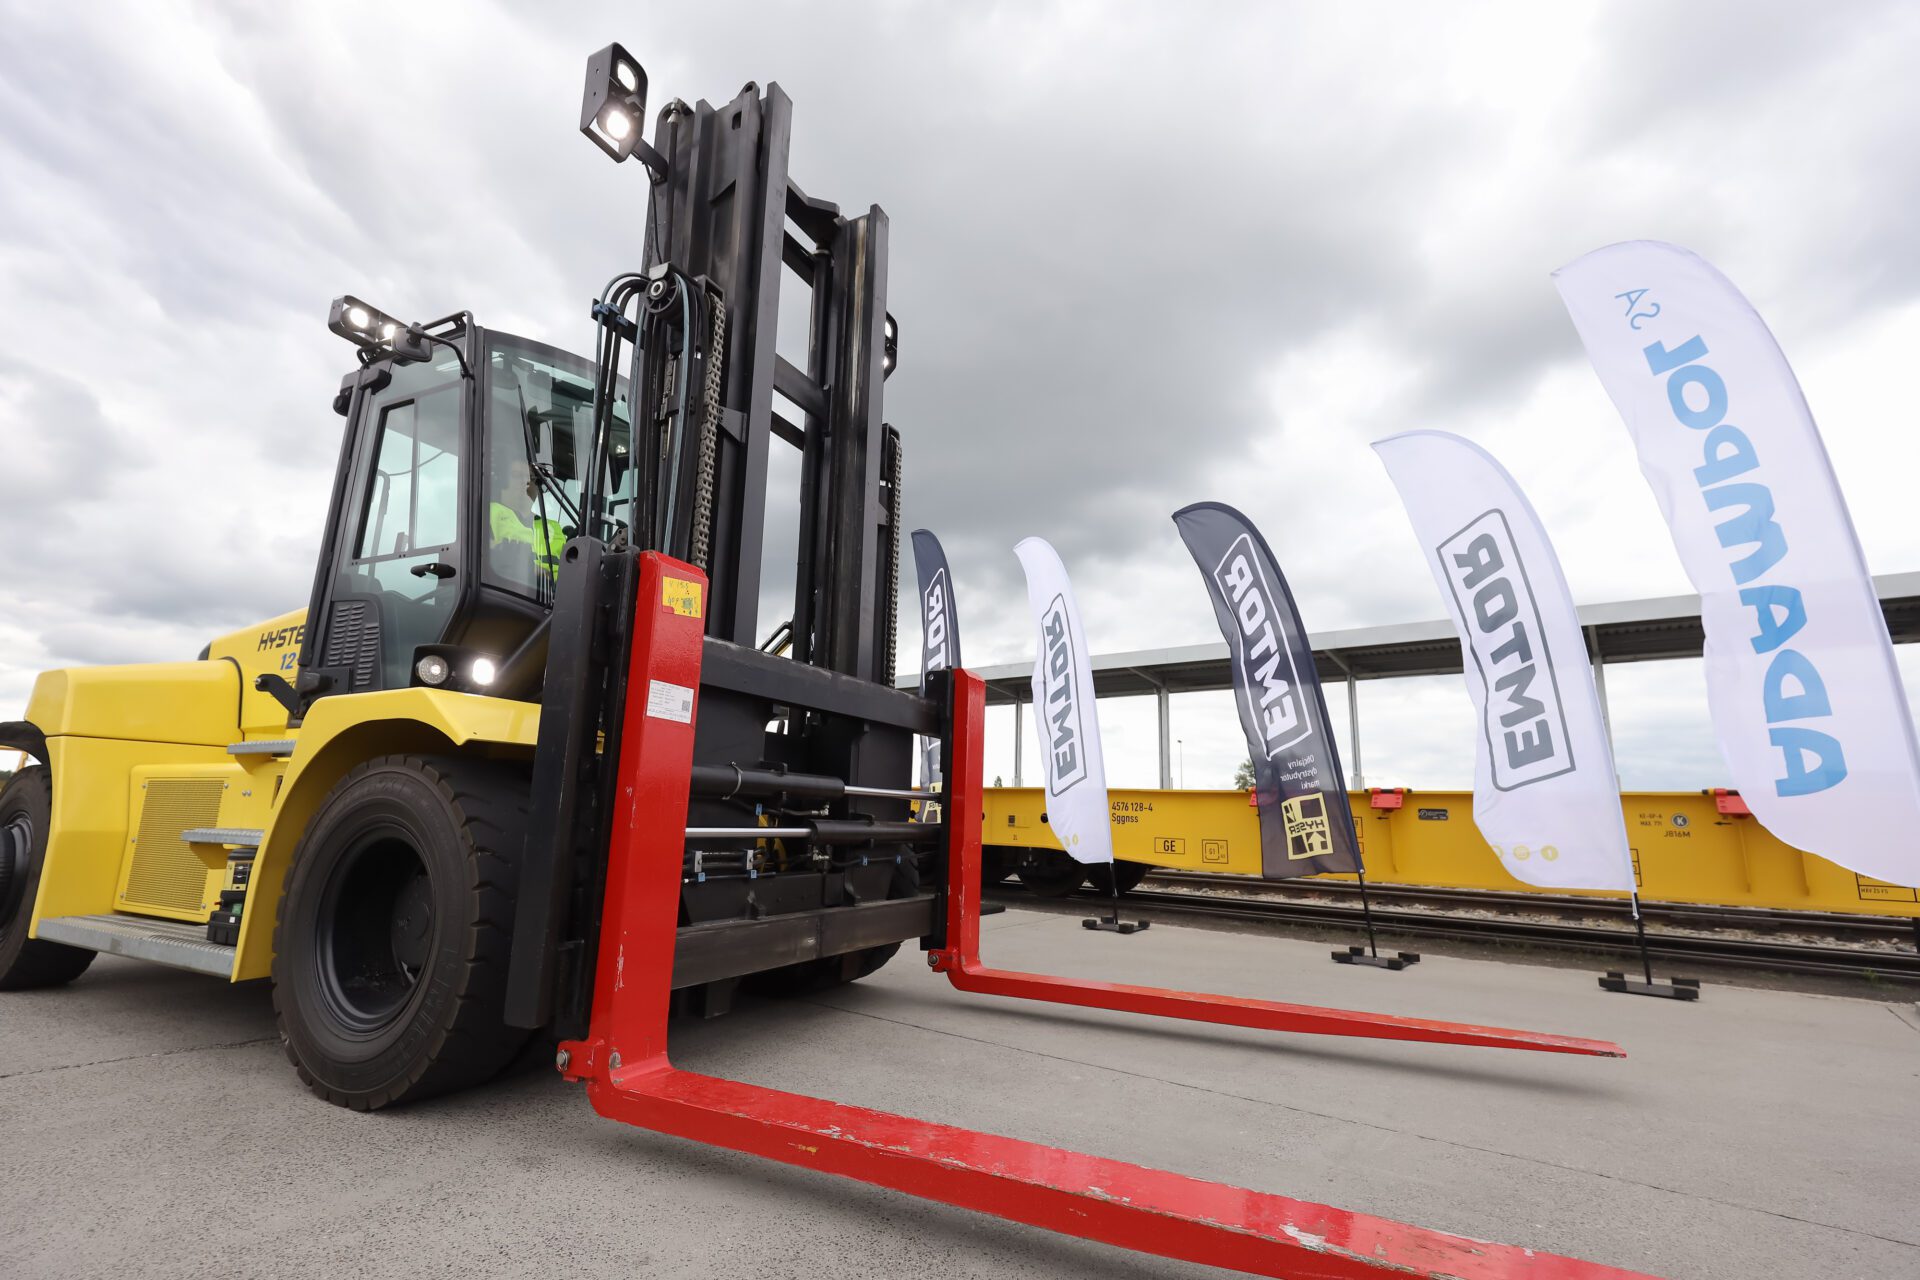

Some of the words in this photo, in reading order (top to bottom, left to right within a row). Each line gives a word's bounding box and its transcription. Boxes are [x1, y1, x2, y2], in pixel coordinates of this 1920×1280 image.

[257, 624, 305, 652] HYSTE
[1111, 802, 1129, 811] 4576
[1131, 803, 1153, 812] 128-4
[1111, 813, 1138, 825] Sggnss
[1163, 840, 1176, 852] GE
